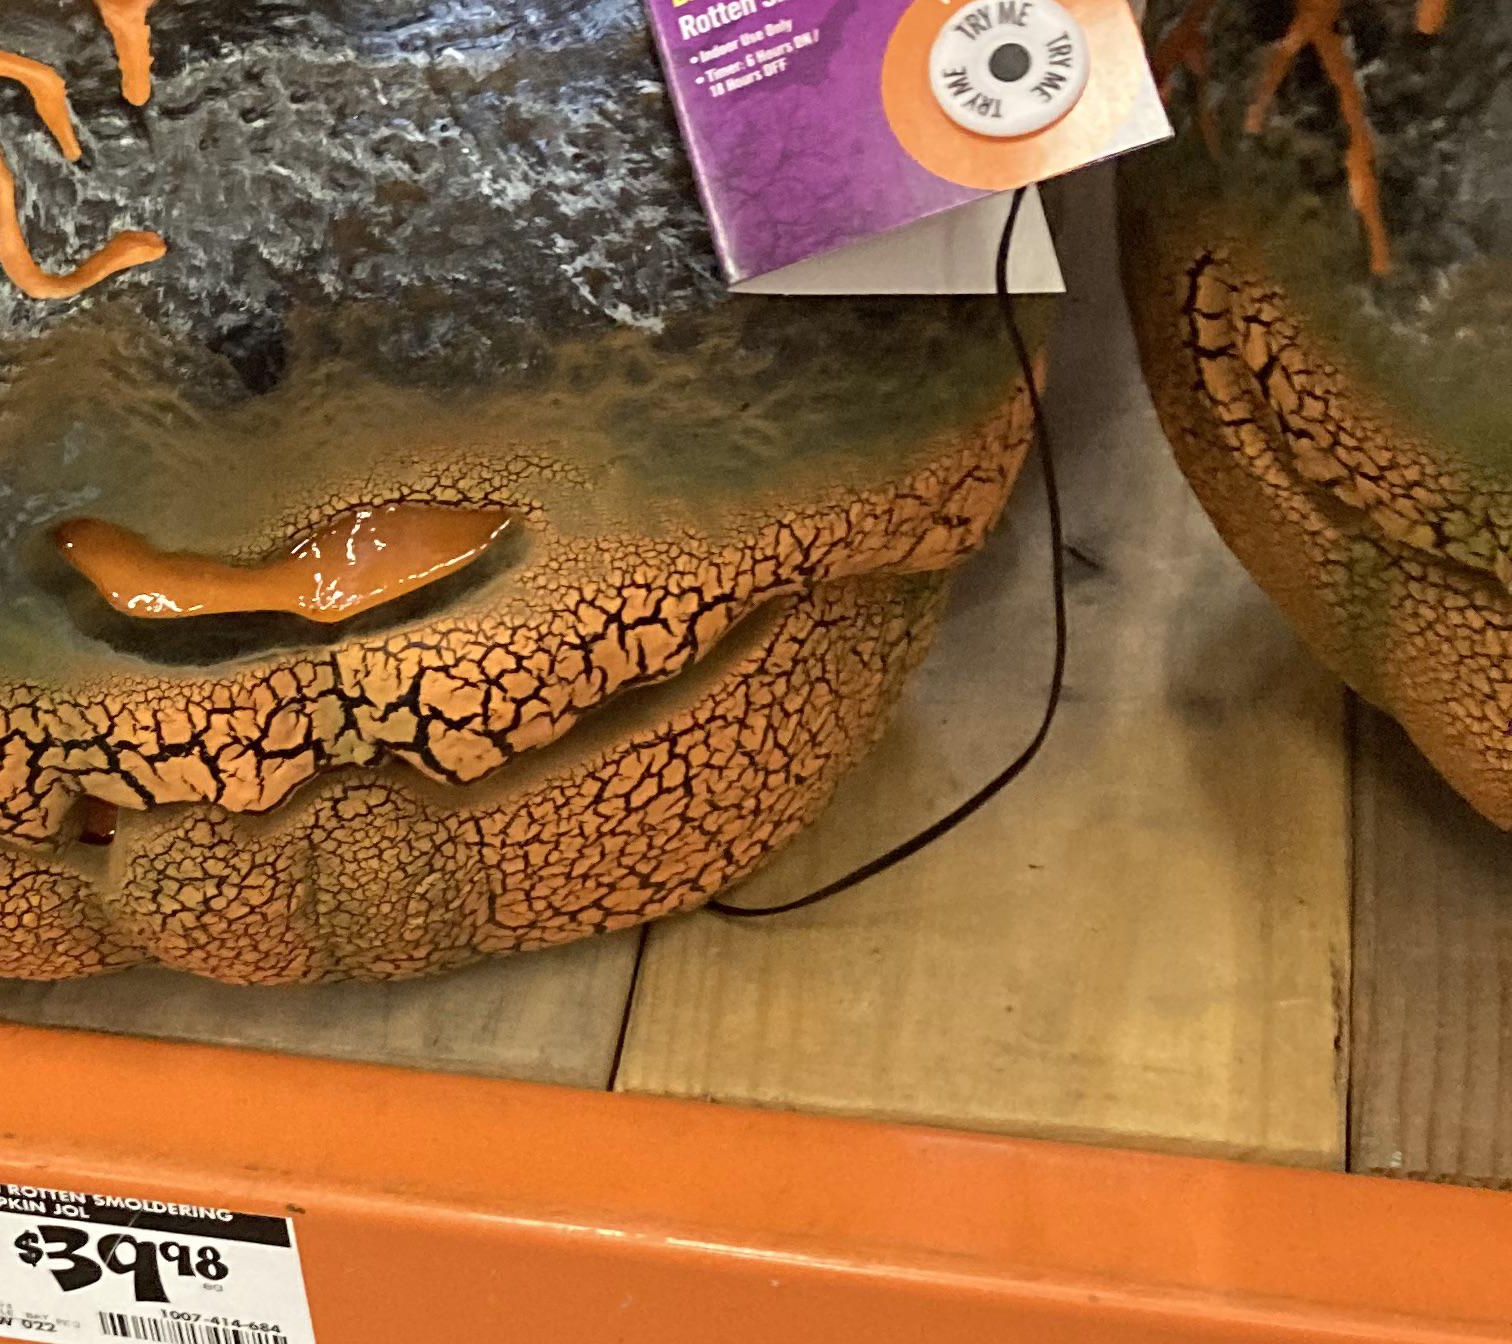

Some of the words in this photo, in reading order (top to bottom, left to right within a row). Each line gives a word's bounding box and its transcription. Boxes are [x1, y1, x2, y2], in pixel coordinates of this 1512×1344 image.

[954, 5, 992, 40] TRY
[999, 1, 1032, 27] ME
[1046, 31, 1074, 68] TRY
[942, 65, 972, 96] ME
[1030, 71, 1066, 103] ME
[964, 93, 1002, 118] TRY
[8, 1183, 86, 1204] ROTTEN
[91, 1194, 233, 1223] SMOLDERING
[54, 1204, 90, 1220] JOL
[21, 1319, 57, 1333] 022
[161, 1308, 281, 1333] 1007-414-684
